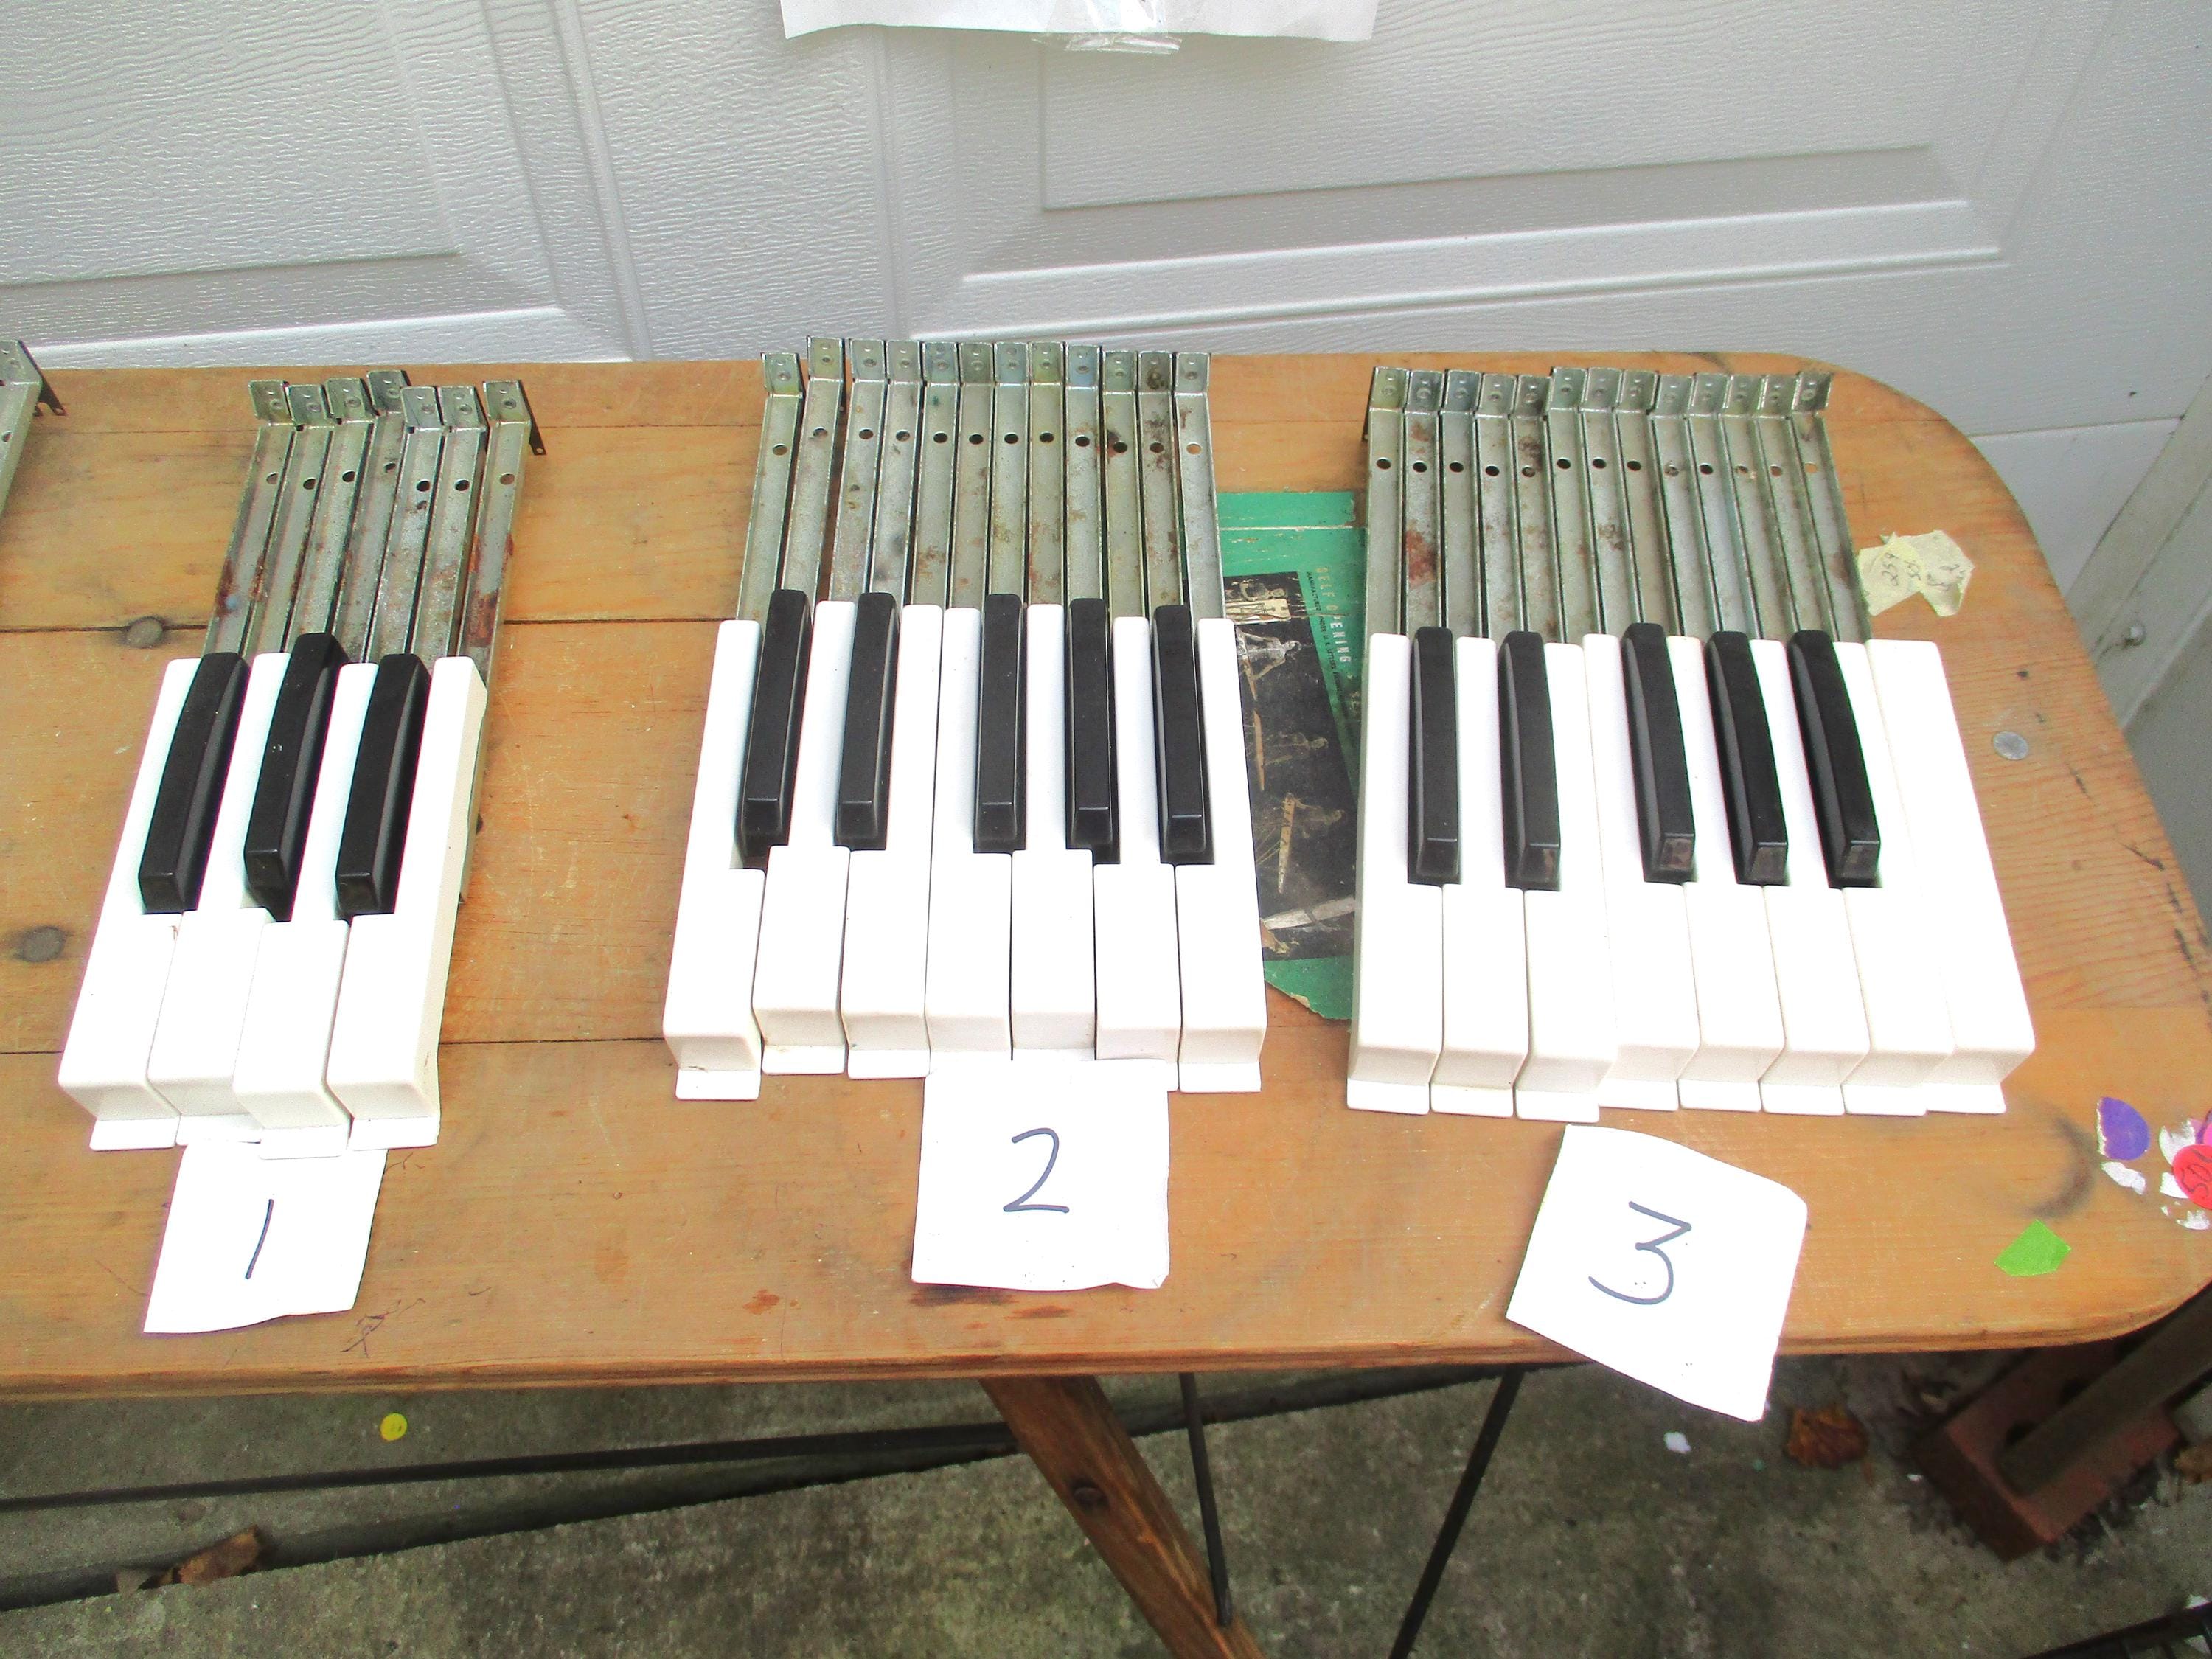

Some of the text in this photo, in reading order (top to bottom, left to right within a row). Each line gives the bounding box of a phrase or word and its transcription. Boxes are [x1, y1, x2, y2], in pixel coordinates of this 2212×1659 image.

[1316, 567, 1335, 597] SELF
[1326, 605, 1352, 662] OPENING
[1003, 1127, 1069, 1213] 2
[245, 1199, 274, 1279] 1
[1588, 1201, 1691, 1304] 3
